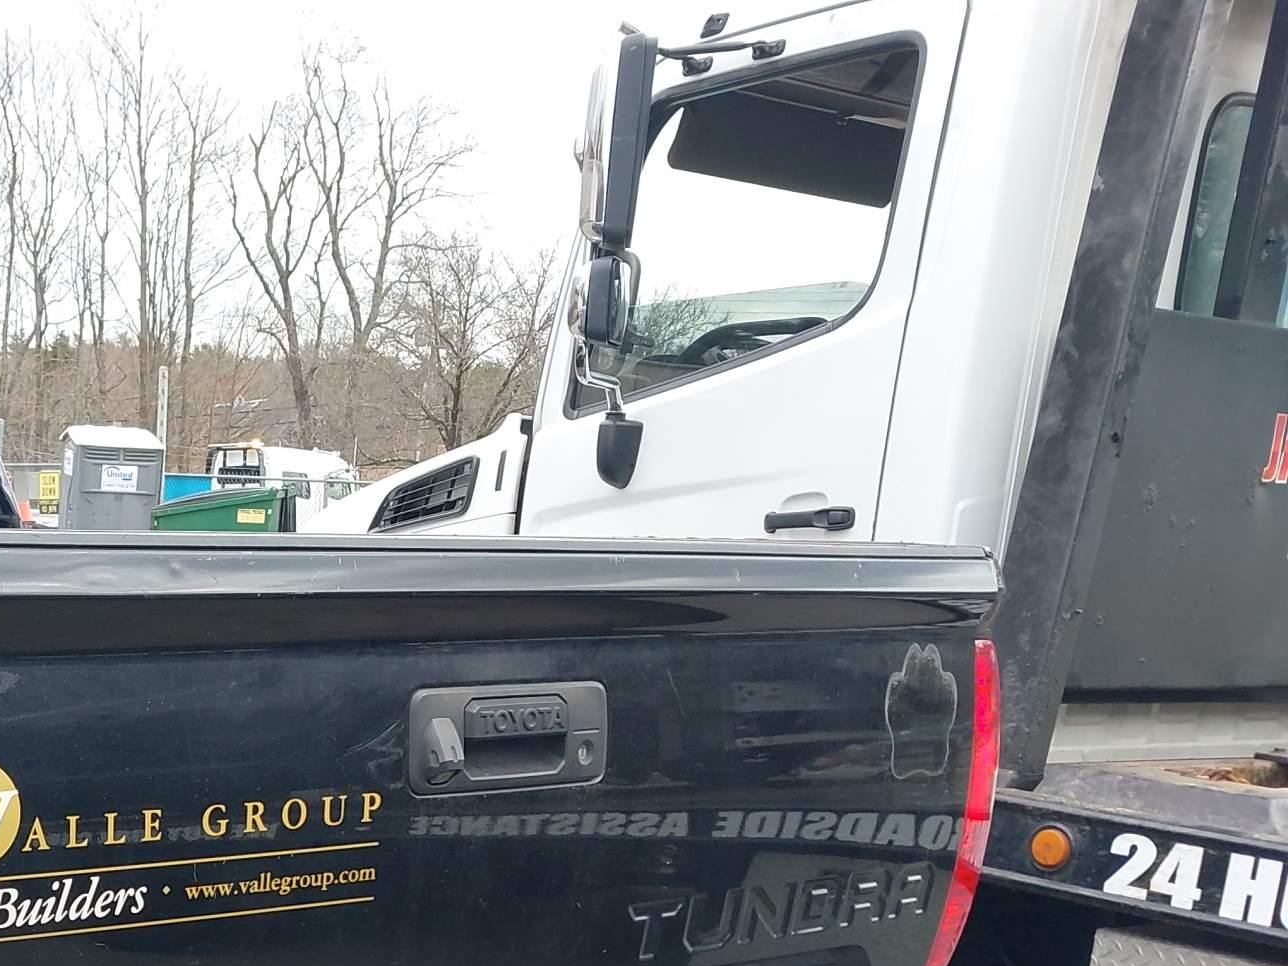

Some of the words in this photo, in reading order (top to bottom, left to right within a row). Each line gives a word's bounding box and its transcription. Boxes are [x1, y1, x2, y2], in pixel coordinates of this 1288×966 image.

[479, 706, 566, 735] TOYOTA
[202, 791, 383, 836] GROUP
[185, 864, 377, 902] www.vallegroup.com
[1103, 833, 1204, 911] 24
[1219, 852, 1288, 930] H
[627, 860, 936, 961] TUNDRA
